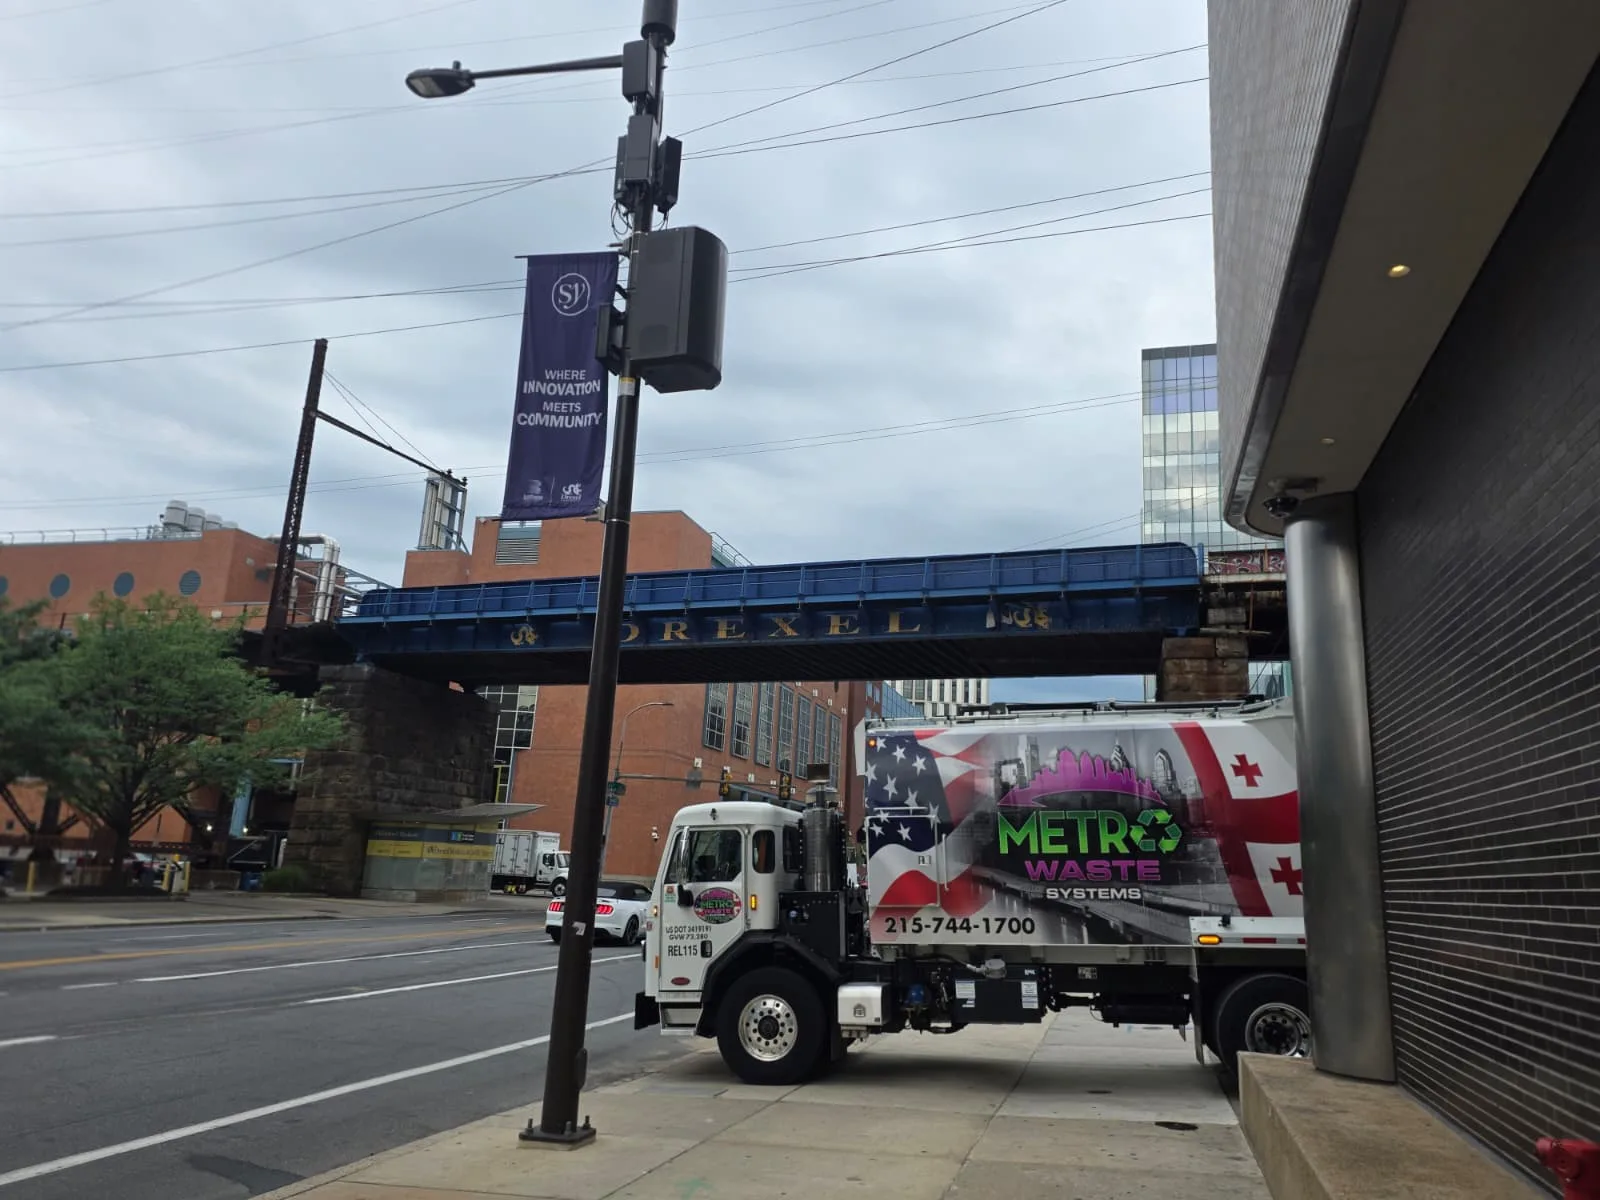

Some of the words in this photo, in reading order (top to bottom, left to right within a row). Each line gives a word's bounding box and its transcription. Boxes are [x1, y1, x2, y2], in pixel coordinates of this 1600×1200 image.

[545, 369, 586, 380] WHERE
[523, 379, 601, 396] INNOVATION
[543, 401, 581, 413] MEETS
[517, 412, 602, 428] COMMUNITY
[1024, 860, 1162, 881] WASTE
[1046, 887, 1142, 900] SYSTEMS
[674, 925, 687, 933] DOT
[885, 917, 1035, 934] 215-744-1700
[668, 944, 698, 956] REL115
